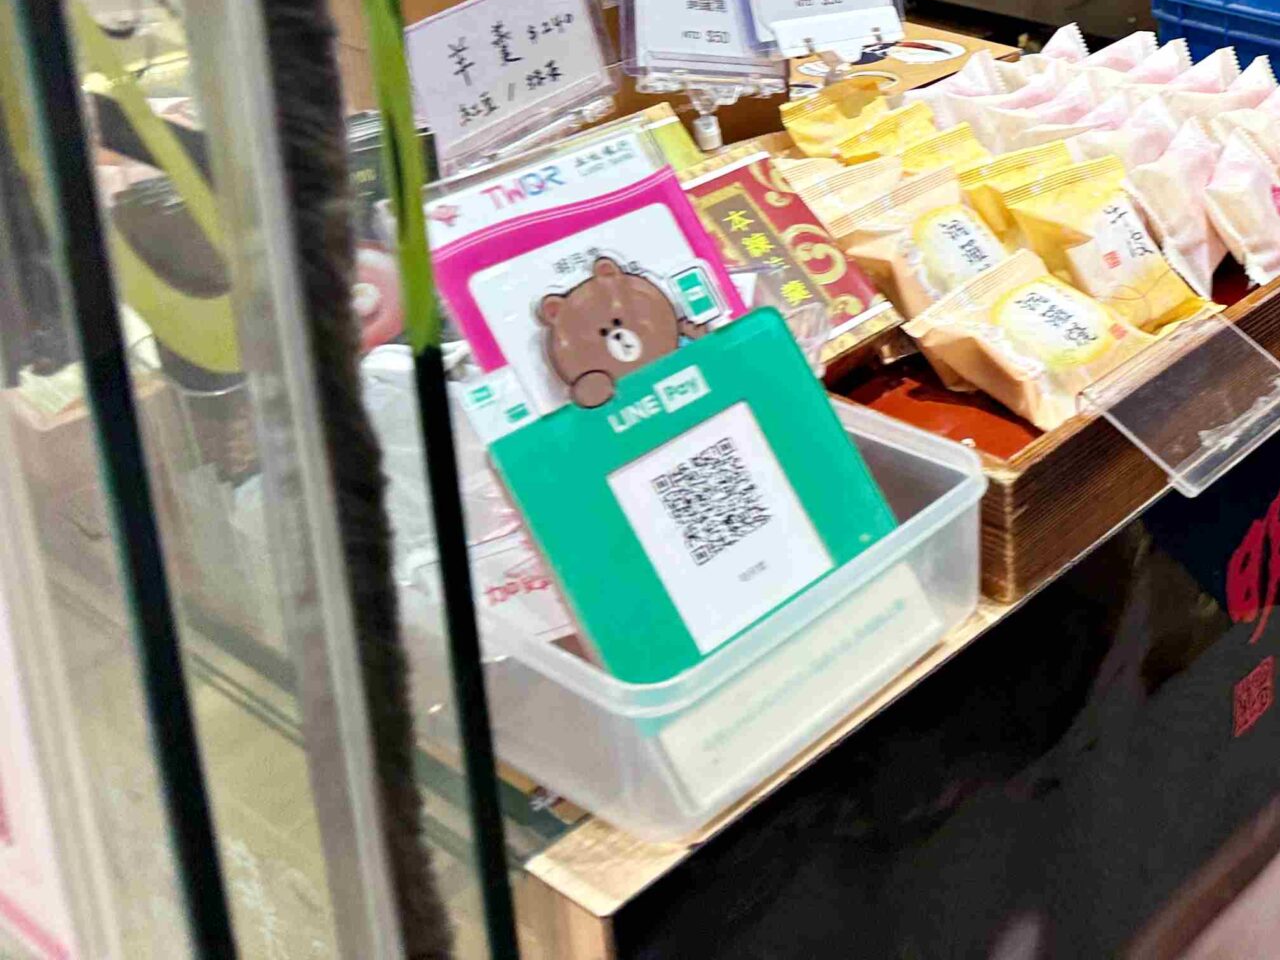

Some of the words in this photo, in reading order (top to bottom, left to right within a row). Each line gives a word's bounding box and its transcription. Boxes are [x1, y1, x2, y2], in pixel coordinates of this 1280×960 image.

[481, 165, 566, 211] TWQR
[607, 394, 663, 434] LINE
[663, 378, 700, 403] Pay
